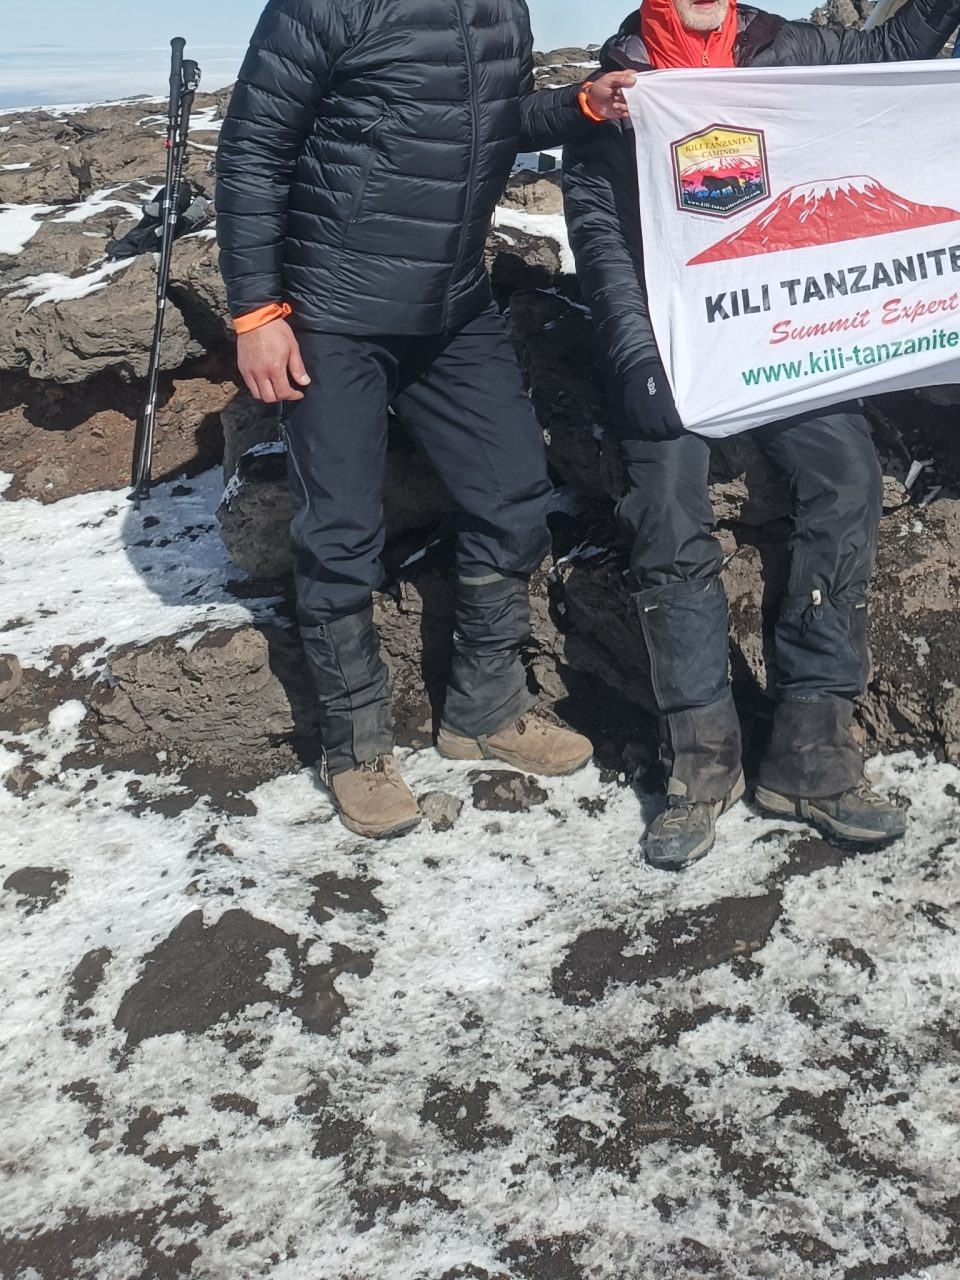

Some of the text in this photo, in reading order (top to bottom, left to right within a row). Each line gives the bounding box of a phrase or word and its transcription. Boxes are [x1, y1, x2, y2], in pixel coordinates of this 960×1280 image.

[685, 136, 753, 153] KILI TANZANITA
[701, 148, 741, 159] CAMINOS
[705, 284, 770, 323] KILI
[769, 308, 871, 346] Summit
[881, 293, 959, 327] Expert
